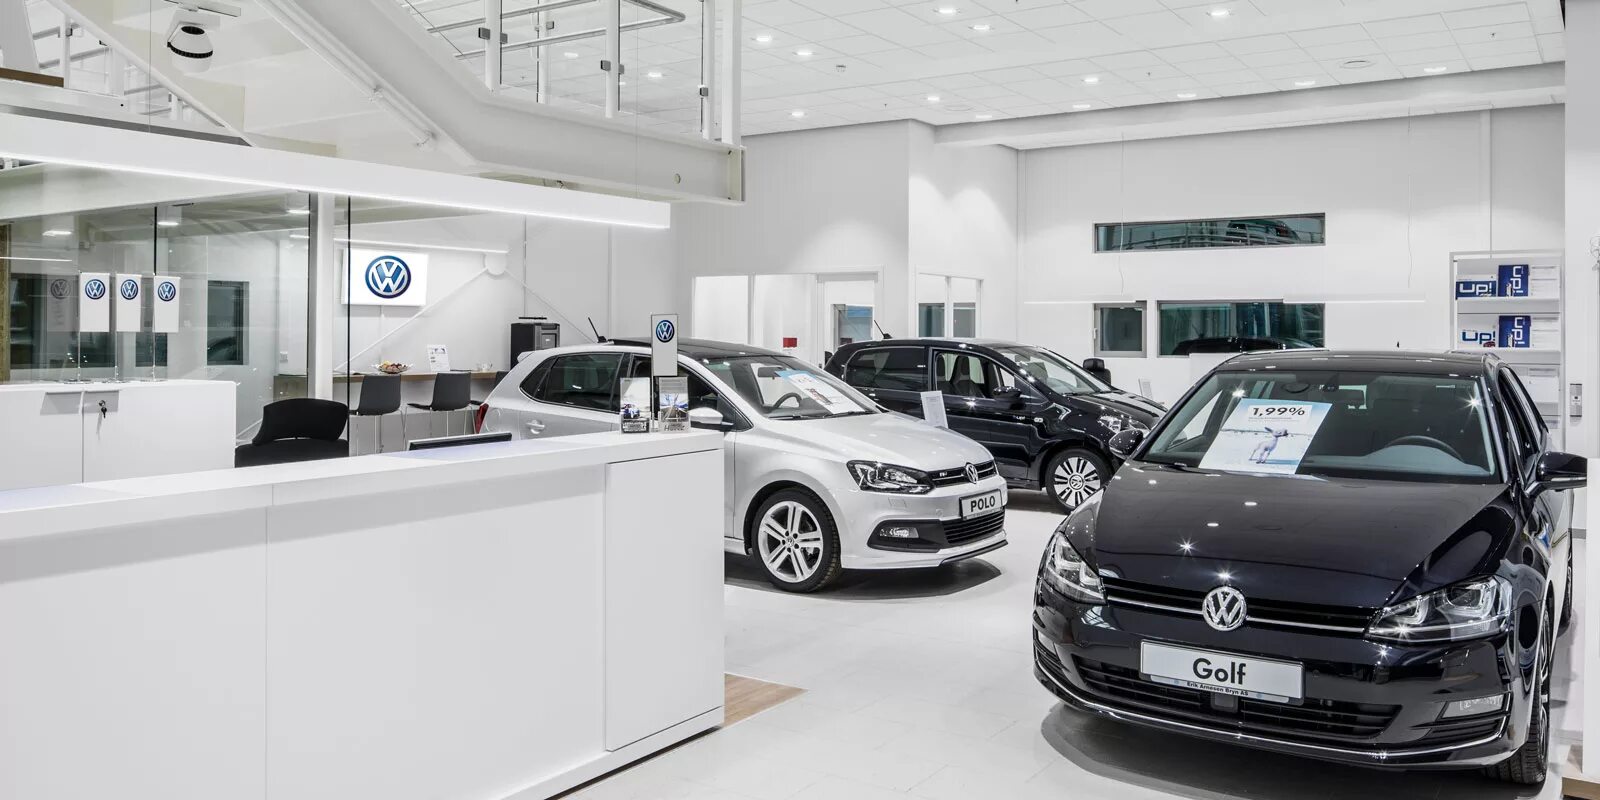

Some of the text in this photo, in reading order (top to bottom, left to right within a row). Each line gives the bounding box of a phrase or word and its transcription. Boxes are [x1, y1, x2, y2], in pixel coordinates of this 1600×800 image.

[1253, 407, 1305, 417] 1,99%
[970, 495, 996, 512] POLO
[1193, 657, 1246, 685] Golf
